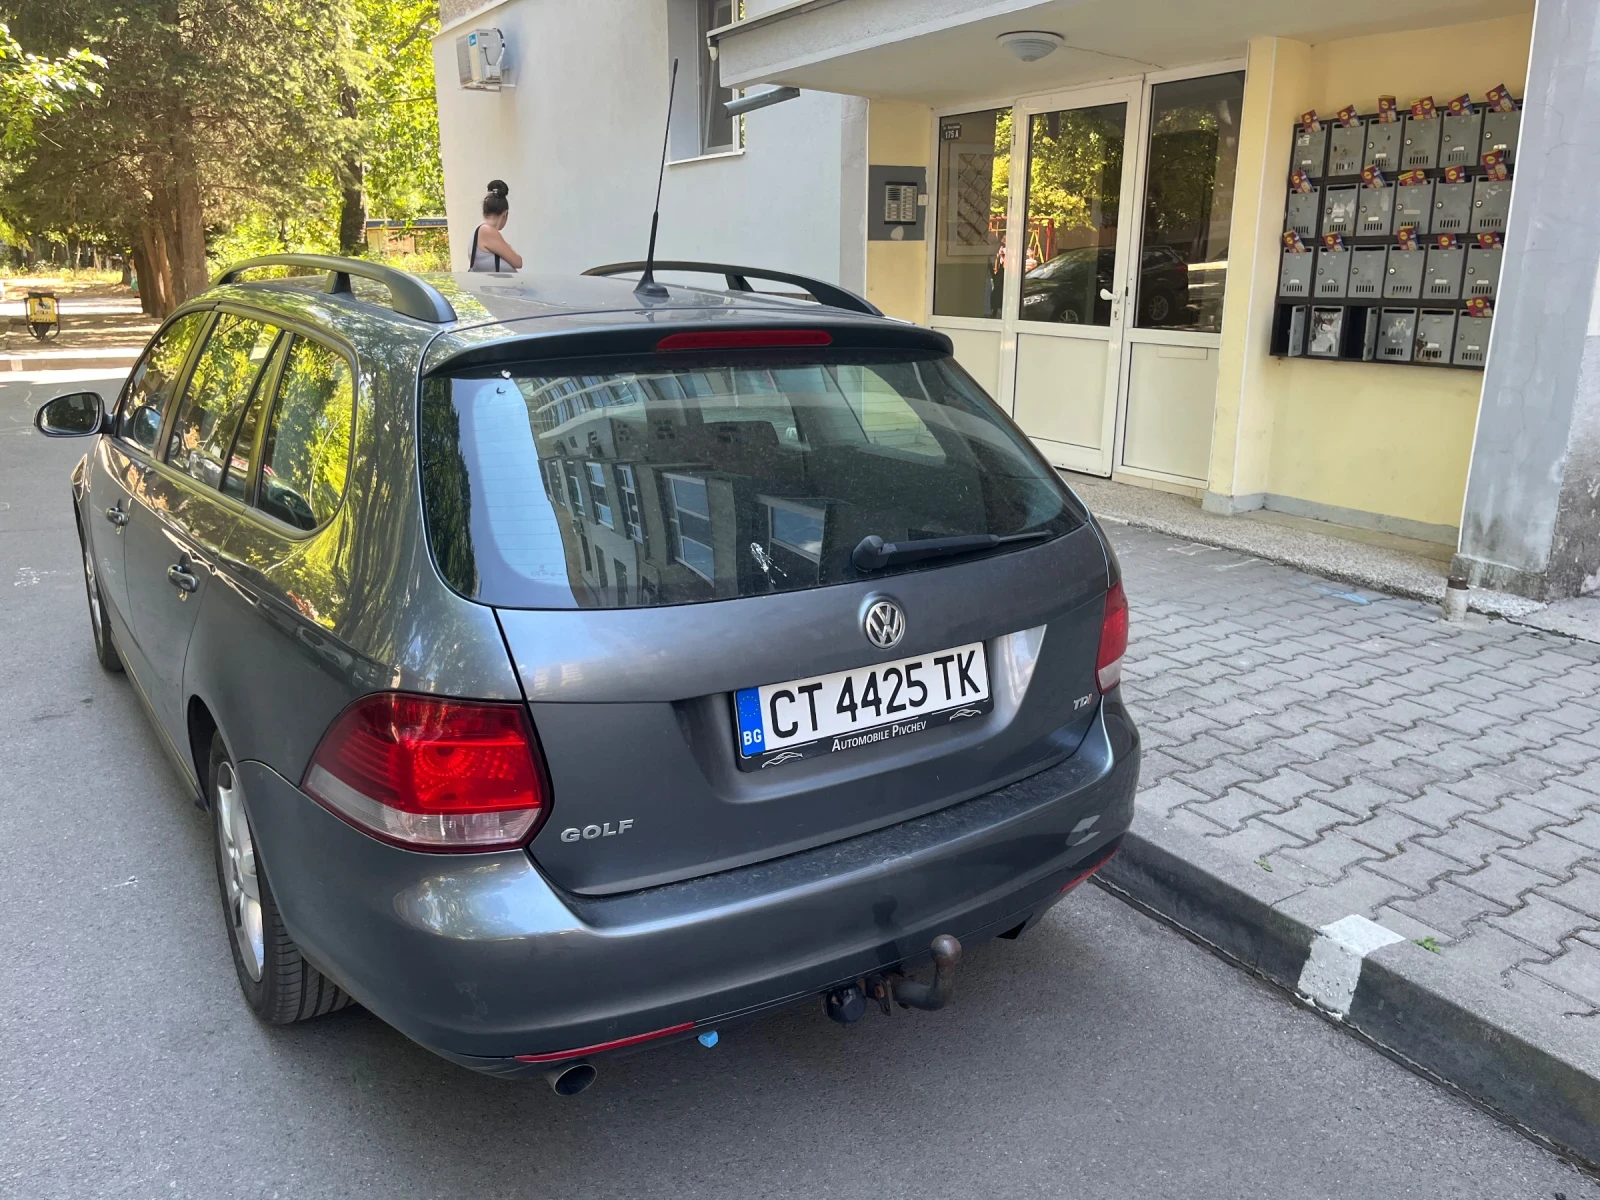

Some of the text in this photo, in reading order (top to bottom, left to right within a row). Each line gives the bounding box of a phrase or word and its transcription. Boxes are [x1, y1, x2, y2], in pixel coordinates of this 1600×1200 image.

[945, 130, 954, 138] 175
[769, 650, 981, 739] CT 4425 TK
[1073, 693, 1092, 711] TDI
[743, 729, 762, 746] BG
[560, 819, 634, 843] GOLF
